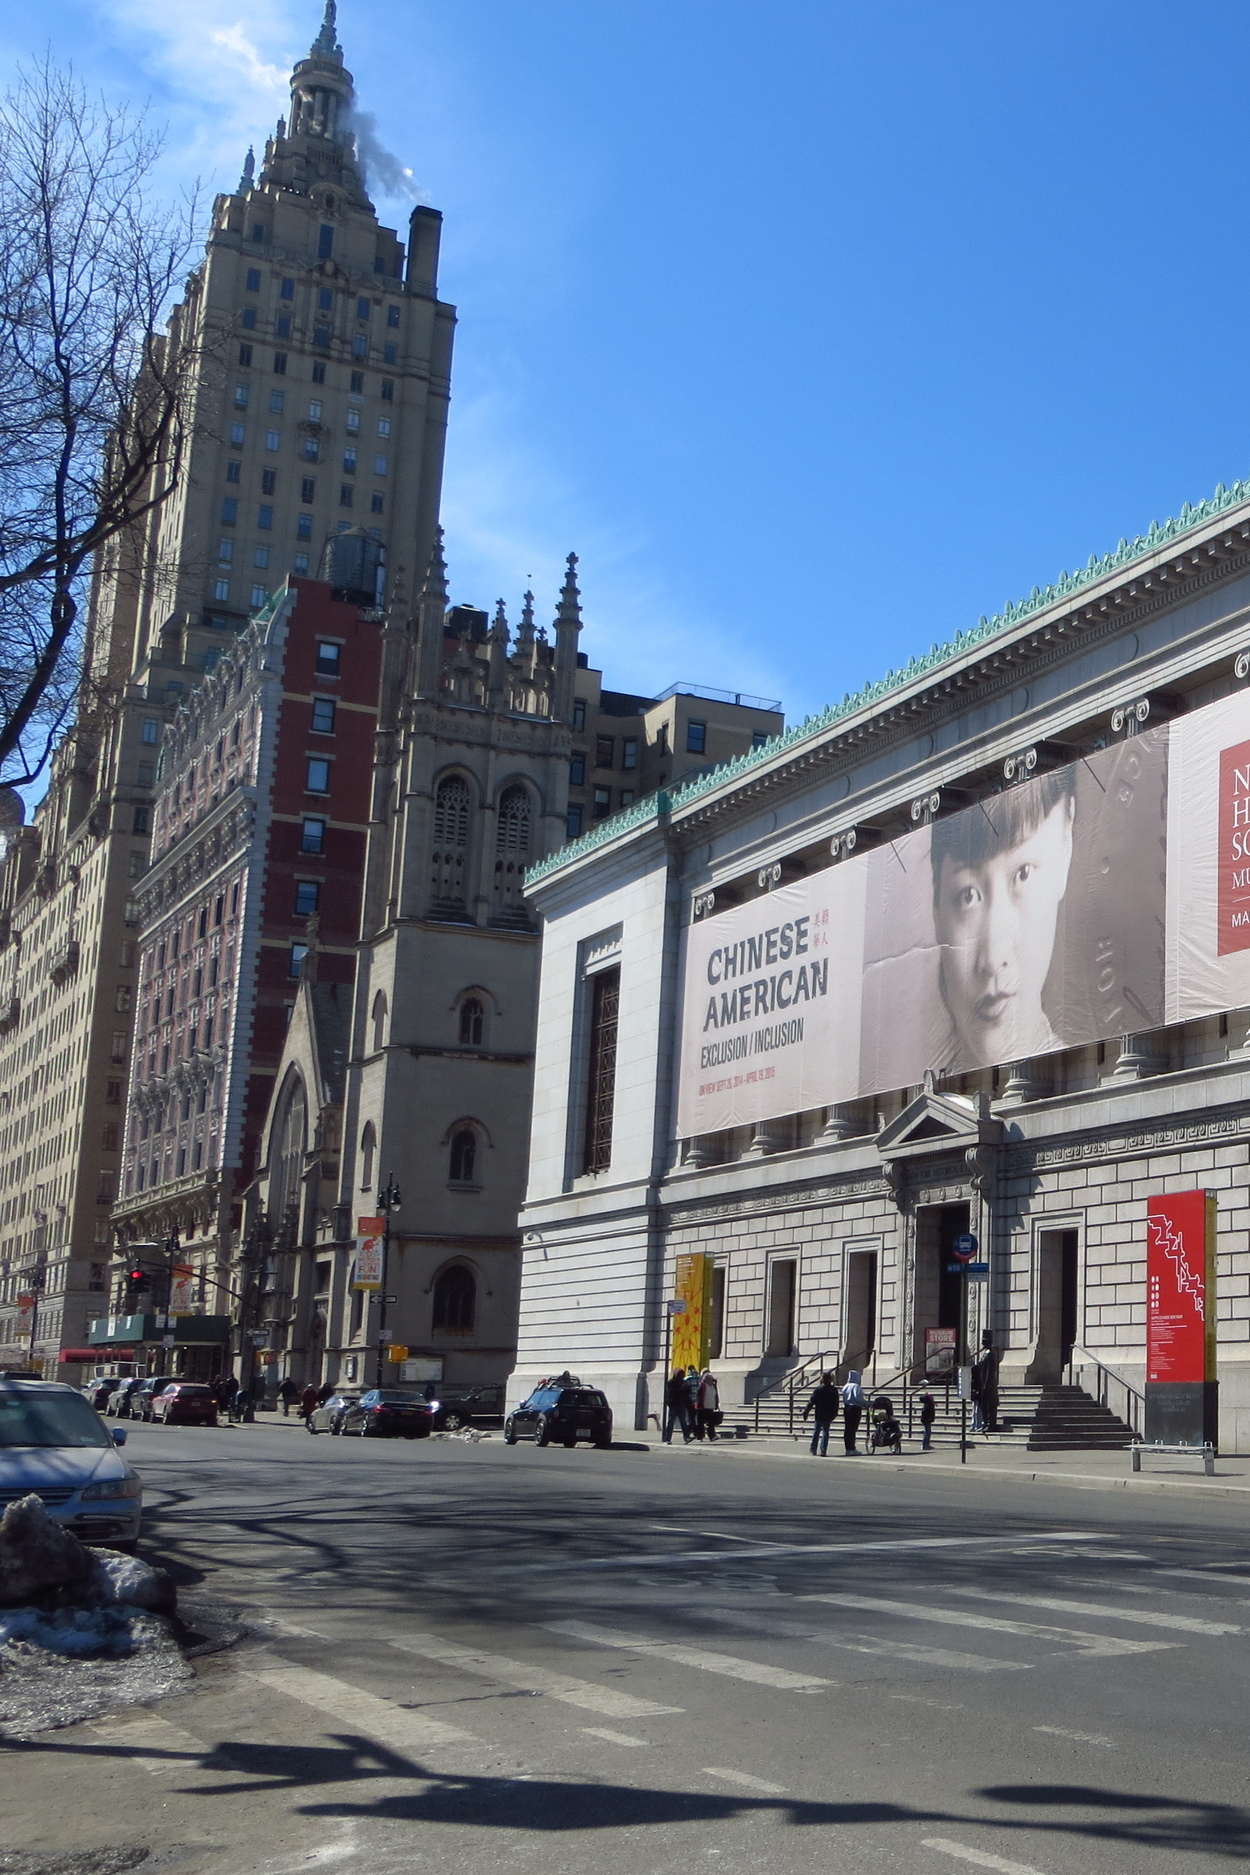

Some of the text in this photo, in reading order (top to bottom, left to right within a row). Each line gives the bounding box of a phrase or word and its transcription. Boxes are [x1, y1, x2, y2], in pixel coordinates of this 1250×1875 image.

[707, 915, 810, 986] CHINESE
[702, 957, 829, 1032] AMERICAN
[700, 1034, 748, 1069] EXCLUSION
[754, 1017, 804, 1054] INCLUSION
[733, 1074, 743, 1088] 2014
[746, 1070, 758, 1084] APRIL
[764, 1065, 776, 1080] 2015
